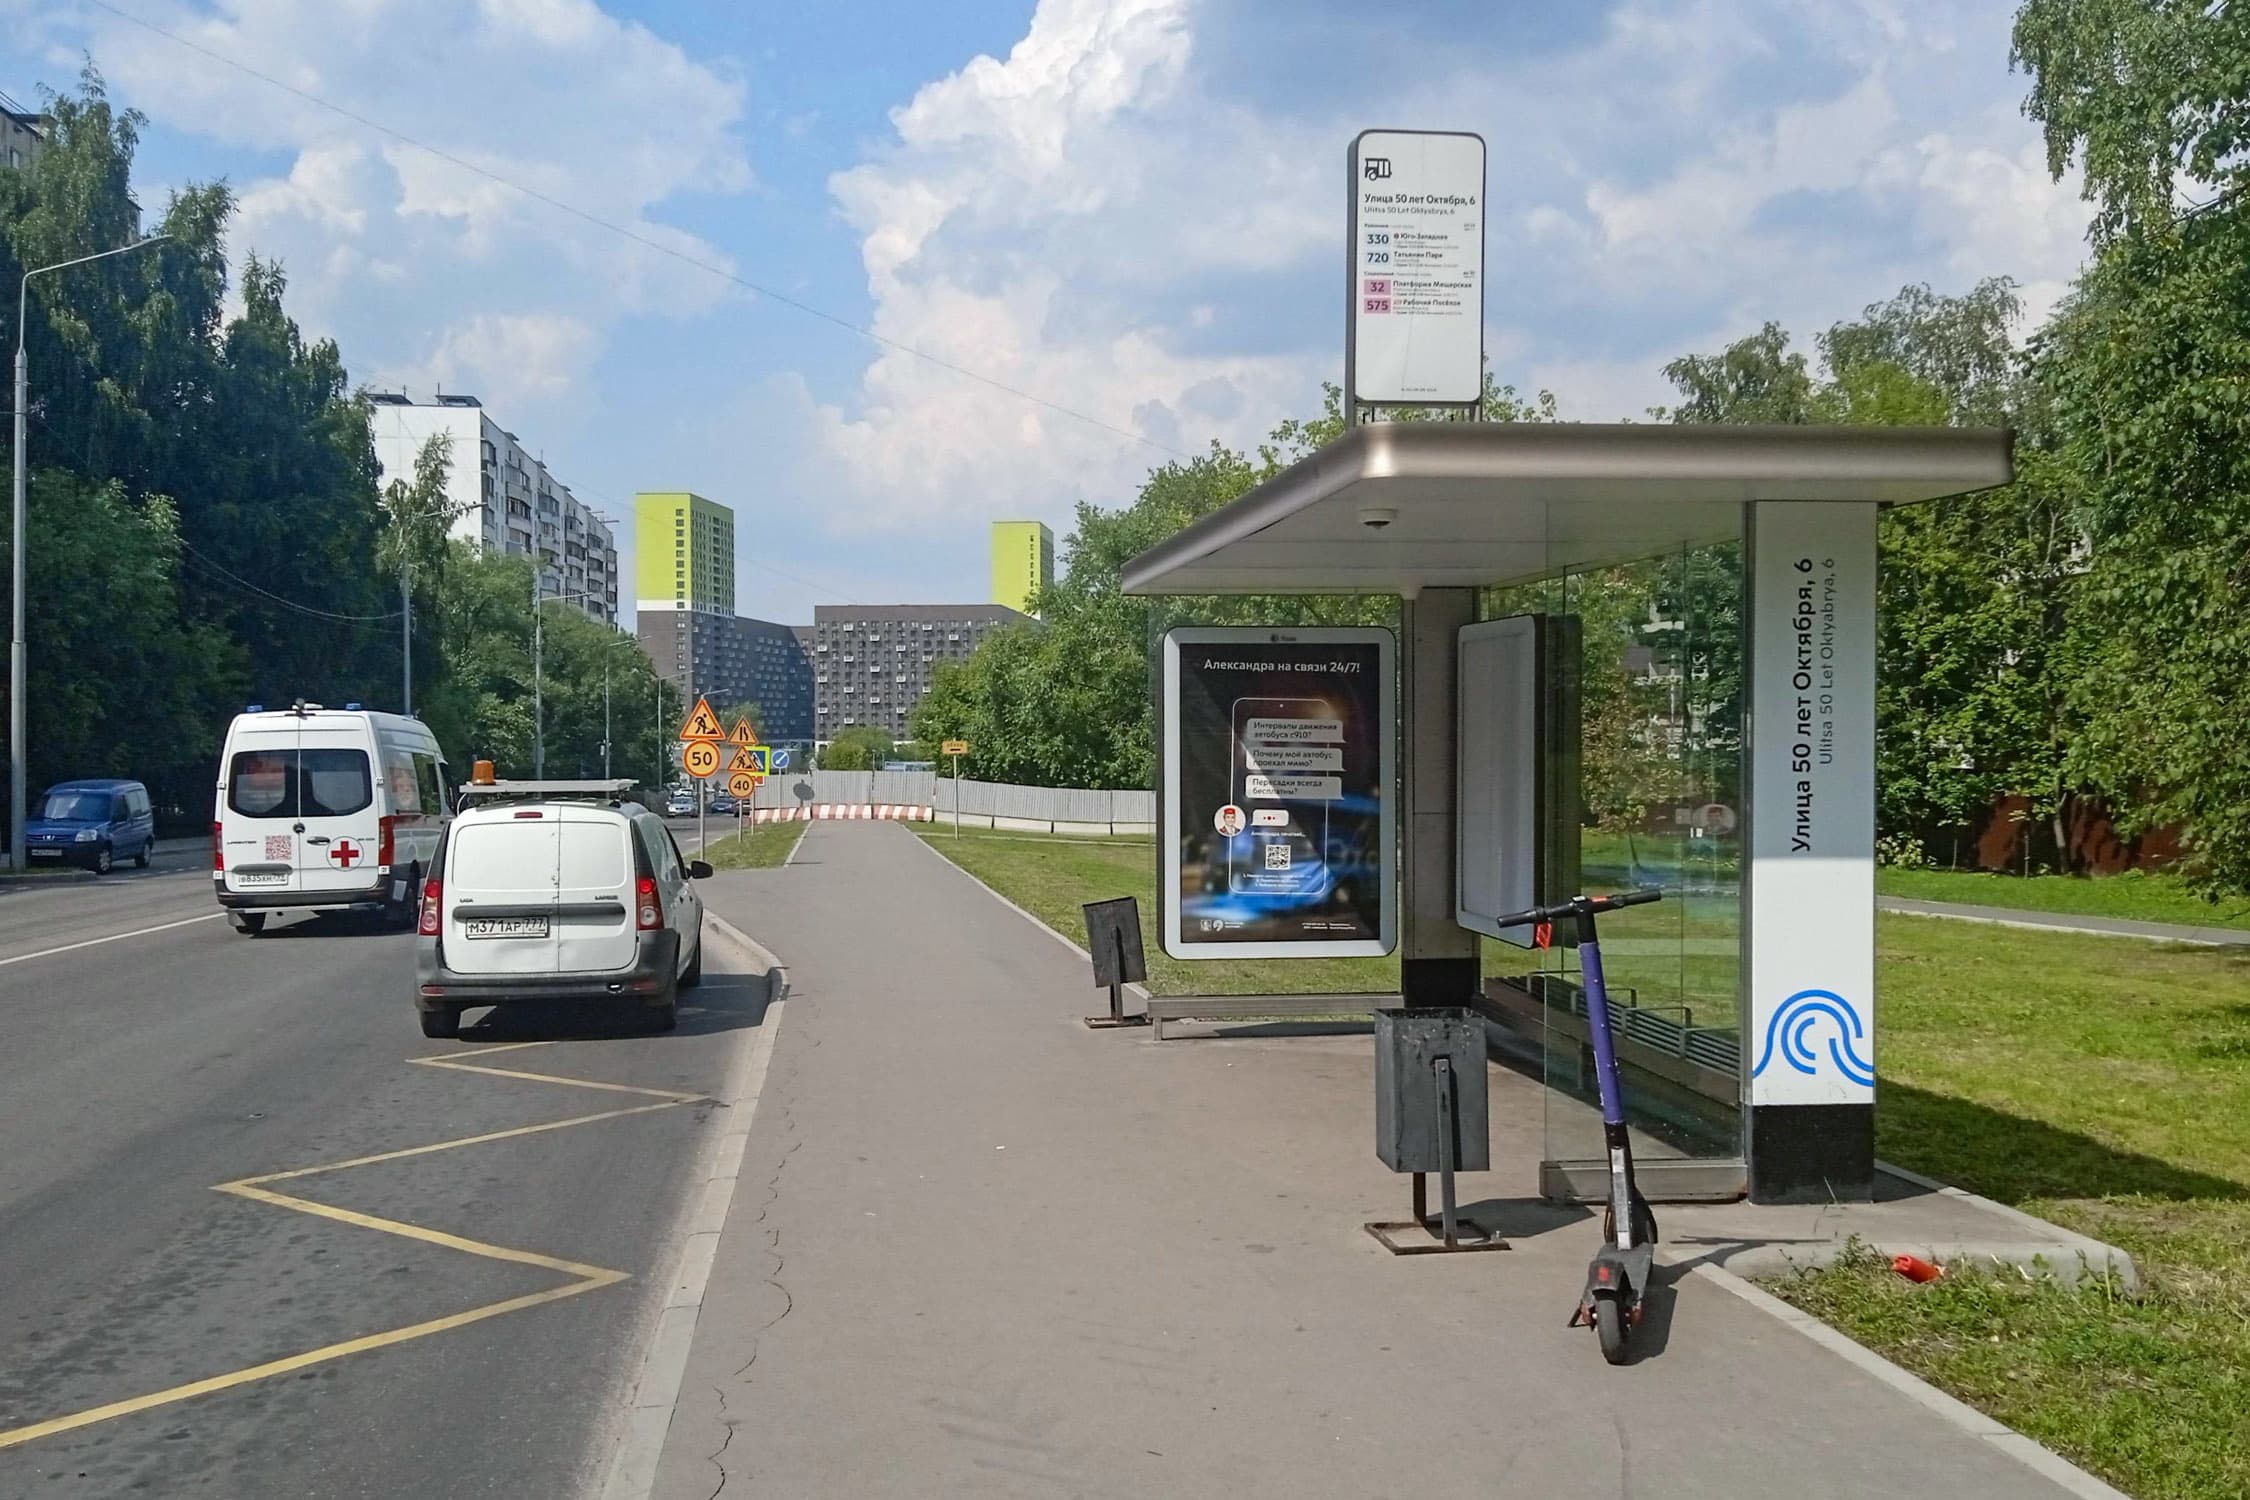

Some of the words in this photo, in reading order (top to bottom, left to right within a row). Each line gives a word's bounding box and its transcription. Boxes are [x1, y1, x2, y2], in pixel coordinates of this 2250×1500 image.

[1364, 193, 1393, 205] Улица
[1395, 193, 1407, 204] 50
[1408, 195, 1424, 204] лет
[1426, 194, 1467, 206] Октября,
[1469, 195, 1476, 205] 6
[1364, 206, 1385, 214] Ulitsa
[1387, 206, 1397, 214] 50
[1397, 206, 1409, 214] Let
[1449, 207, 1455, 215] 6
[1367, 233, 1389, 245] 330
[1367, 252, 1389, 263] 720
[1370, 281, 1385, 293] 32
[1367, 300, 1389, 311] 575
[1793, 557, 1813, 573] 6
[1821, 558, 1834, 569] 6
[1820, 571, 1836, 654] Oktyabrya,
[1792, 579, 1816, 692] Октября,
[1203, 658, 1275, 672] Александра
[1278, 662, 1291, 671] на
[1294, 663, 1327, 672] связи
[1329, 661, 1360, 673] 24/7!
[1820, 663, 1833, 690] Let
[1820, 694, 1833, 714] 50
[1796, 697, 1811, 737] лет
[1253, 721, 1297, 730] Интервалы
[1254, 731, 1288, 739] автобуса
[1819, 718, 1833, 765] Ulitsa
[692, 752, 712, 766] 50
[1253, 749, 1283, 759] Почему
[1285, 750, 1301, 758] мой
[1302, 750, 1333, 760] автобус
[1792, 743, 1811, 774] 50
[1287, 759, 1313, 767] мимо?
[734, 780, 750, 791] 40
[1792, 780, 1813, 852] Улица
[523, 918, 545, 928] 777
